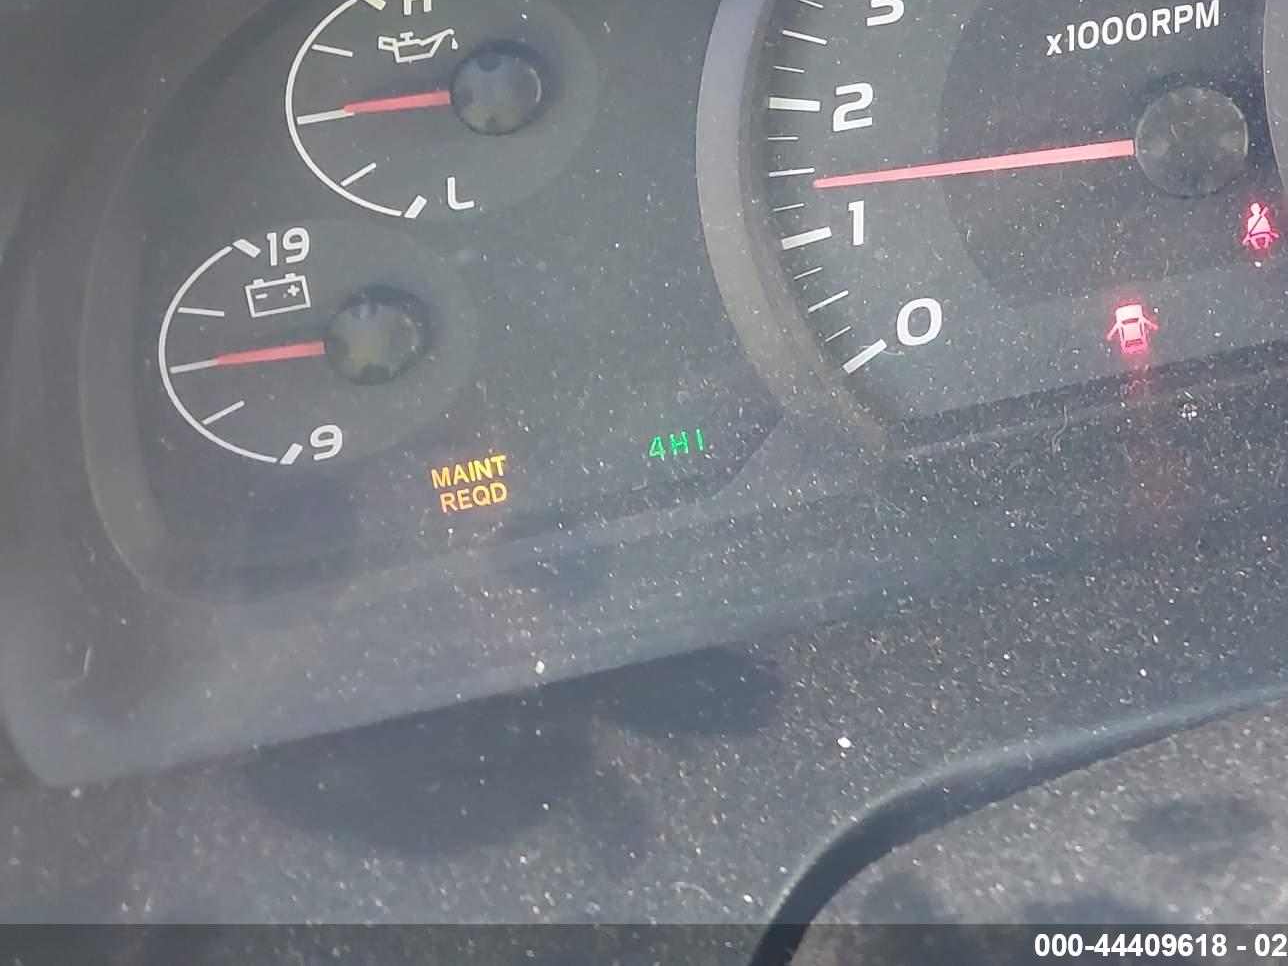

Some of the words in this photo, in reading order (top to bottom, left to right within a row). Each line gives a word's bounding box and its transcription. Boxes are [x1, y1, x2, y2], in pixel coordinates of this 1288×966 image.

[832, 82, 874, 132] 2
[447, 176, 475, 210] L
[848, 200, 865, 246] 1
[266, 227, 310, 266] 19
[896, 297, 943, 346] 0
[309, 424, 343, 461] 9
[431, 454, 508, 490] MAINT
[439, 480, 508, 513] REQD
